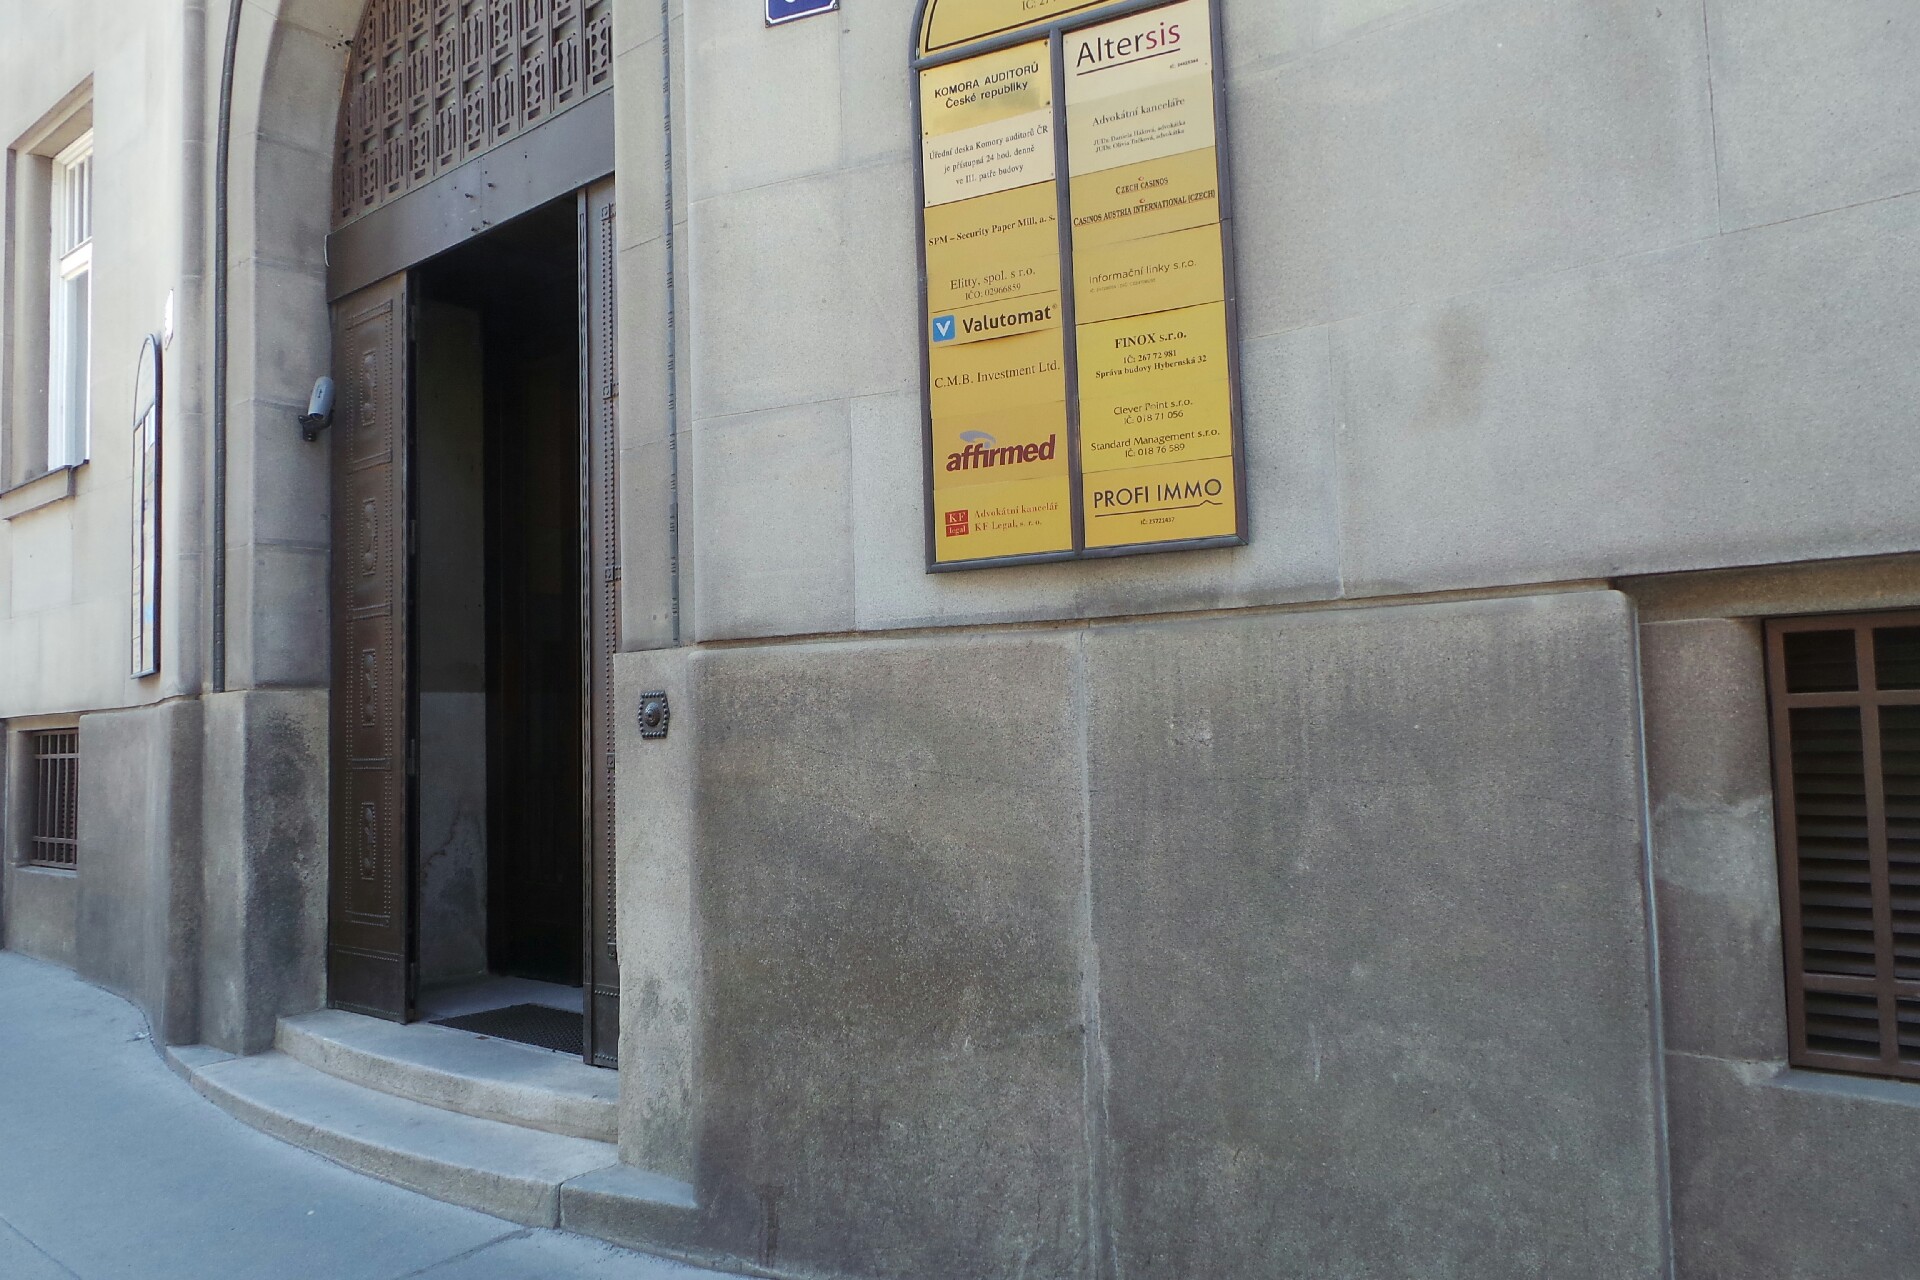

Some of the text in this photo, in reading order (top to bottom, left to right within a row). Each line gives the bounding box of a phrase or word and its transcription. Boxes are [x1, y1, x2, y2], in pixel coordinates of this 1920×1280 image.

[1076, 22, 1181, 68] Altersis
[934, 61, 1039, 99] KOMORA AUDITORŮ
[945, 81, 1028, 109] České republiky
[1092, 98, 1186, 127] Advokátní kanceláře
[954, 144, 974, 155] deska
[976, 137, 1004, 150] Komory
[1005, 127, 1035, 142] auditorů
[1036, 124, 1049, 135] ČR
[943, 144, 1035, 174] je přístupná 24 hod. denně
[979, 169, 996, 182] patře
[998, 164, 1024, 177] budovy
[1115, 177, 1169, 195] CZECH CASINOS
[1073, 189, 1215, 226] CASINOS AUSTRIA INTERNATIONAL (CZECH)
[928, 235, 948, 246] SPM
[956, 228, 989, 242] Security
[991, 222, 1016, 234] Paper
[1146, 263, 1170, 275] linky
[1173, 259, 1197, 270] s.r.o.
[950, 267, 1036, 291] Elitty, spol. s r.o.
[965, 287, 983, 300] IČO:
[1114, 331, 1187, 349] FINOX s.r.o.
[1095, 355, 1207, 379] Správa budovy Hybernská 32
[1123, 349, 1177, 364] IČ: 267 72 981
[934, 360, 1060, 389] C.M.B. Investment Ltd.
[1113, 399, 1193, 416] Clever Point s.r.o.
[1136, 413, 1153, 423] 018
[1154, 412, 1165, 421] 71
[1167, 410, 1184, 419] 056
[1091, 429, 1220, 451] Standard Management s.r.o.
[1125, 443, 1185, 458] IČ: 018 76 589
[946, 433, 1056, 472] affirmed
[1094, 478, 1222, 509] PROFI IMMO
[949, 512, 966, 523] KF
[975, 522, 989, 532] KF
[949, 525, 966, 536] legal
